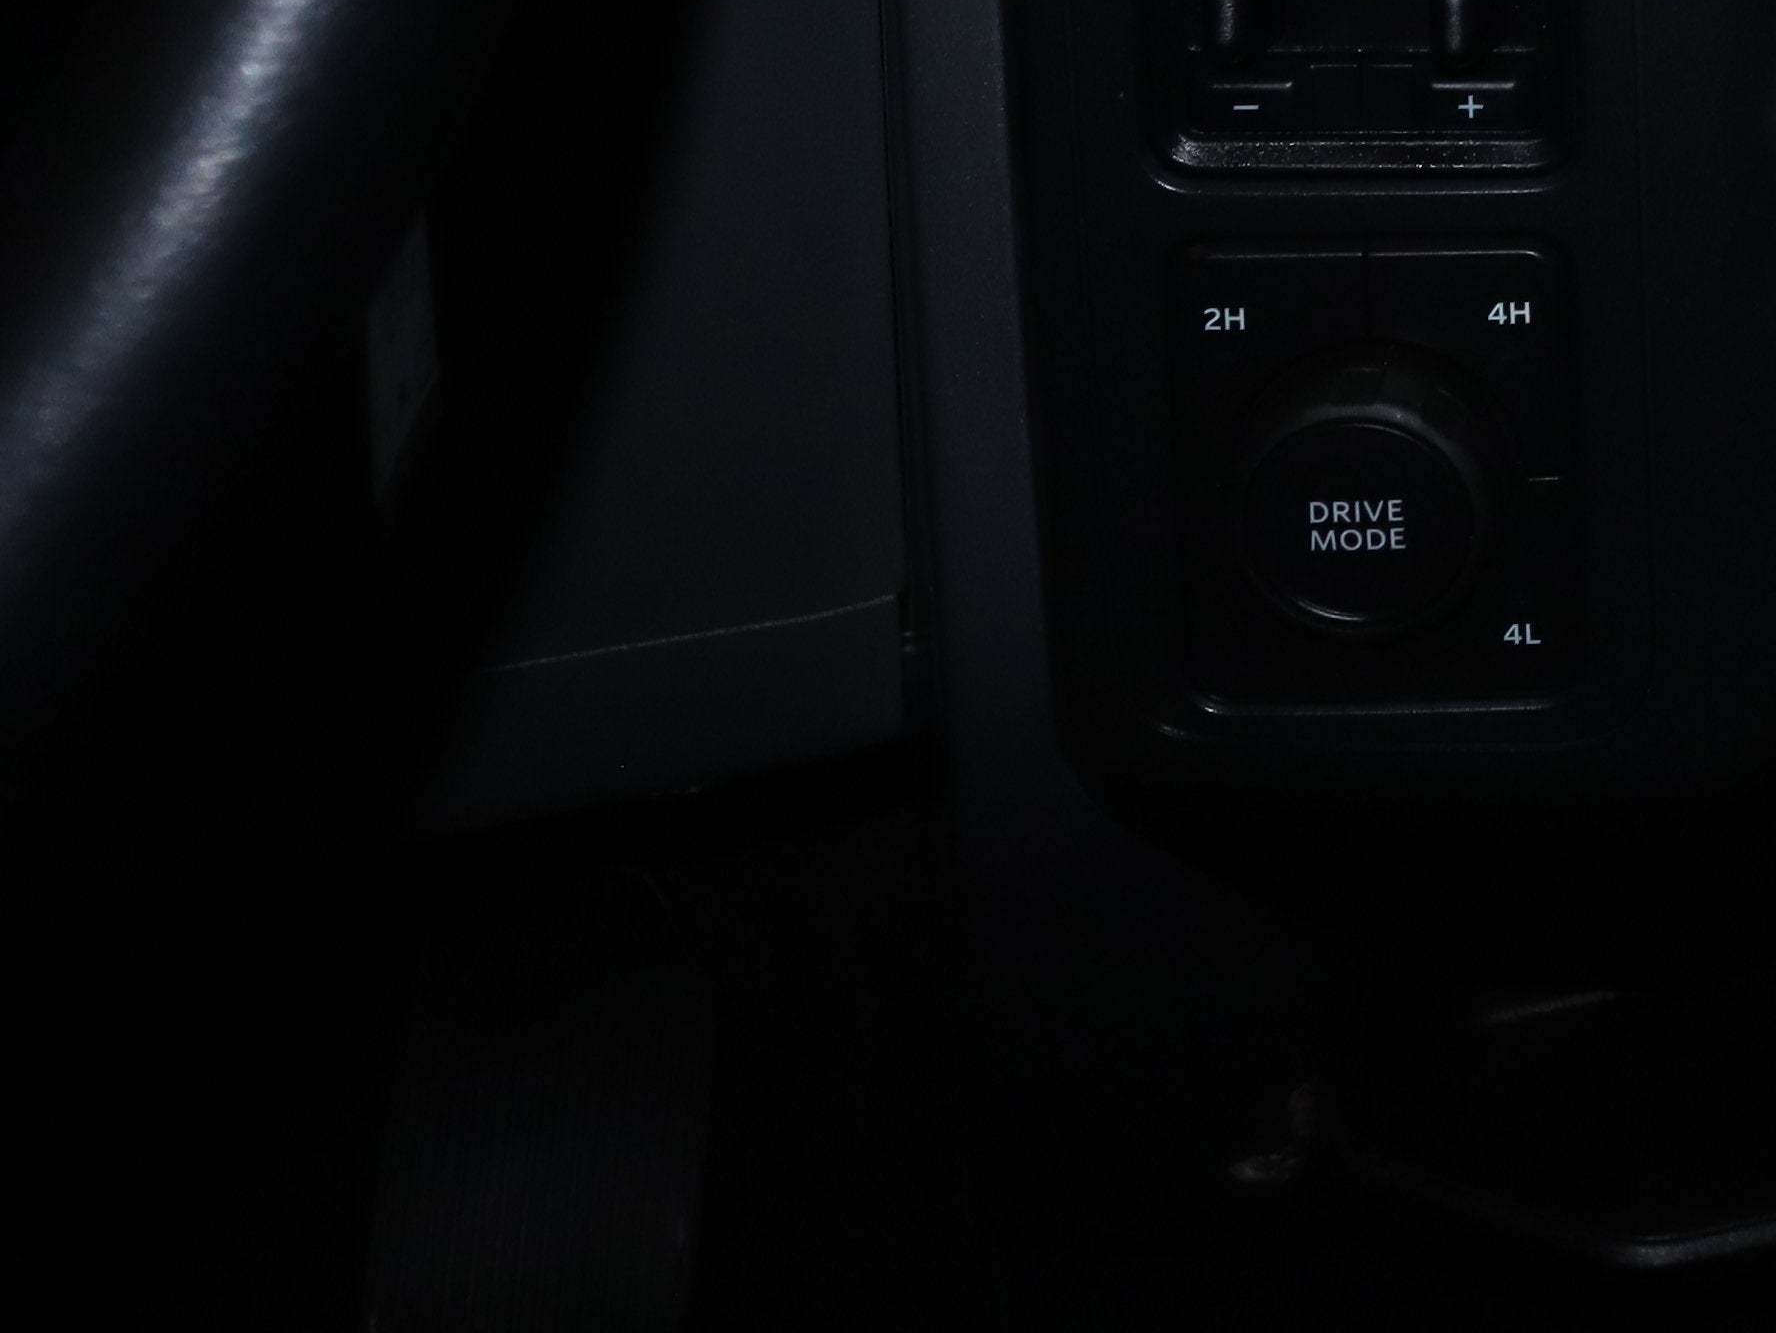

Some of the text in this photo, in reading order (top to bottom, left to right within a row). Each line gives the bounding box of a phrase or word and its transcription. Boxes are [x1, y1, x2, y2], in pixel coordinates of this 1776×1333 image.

[1202, 307, 1247, 333] 2H
[1486, 300, 1532, 327] 4H
[1307, 499, 1405, 527] DRIVE
[1308, 527, 1407, 554] MODE
[1501, 623, 1542, 648] 4L
